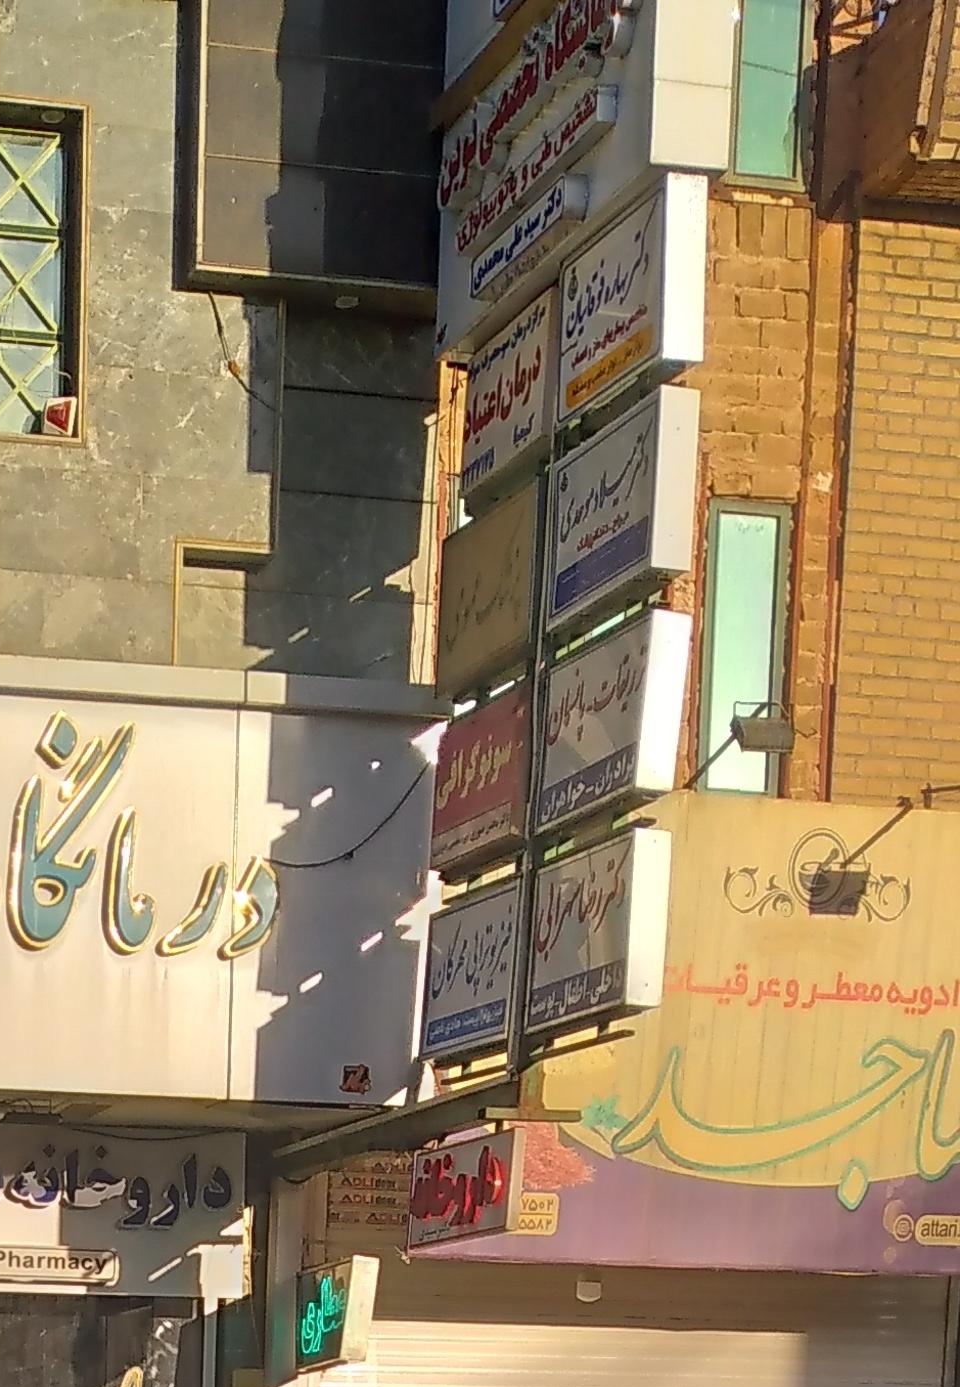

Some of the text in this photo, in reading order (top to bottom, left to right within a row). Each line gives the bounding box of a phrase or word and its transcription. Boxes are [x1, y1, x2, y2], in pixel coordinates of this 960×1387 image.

[520, 163, 529, 189] و
[531, 131, 552, 178] طبی
[523, 213, 542, 239] سید
[542, 188, 562, 226] دکتر
[473, 246, 503, 291] محمدی
[505, 228, 523, 261] علی
[464, 345, 542, 446] درمان اعتیاد
[436, 734, 512, 810] سونوگرافی
[534, 837, 634, 963] دکتر رضا سهرابی
[431, 904, 513, 1000] فیزیوتراپی مهرگان
[664, 962, 960, 1016] ادویه معطر و عرقیات
[12, 1144, 232, 1229] داروخانه
[410, 1145, 505, 1227] داروخانه
